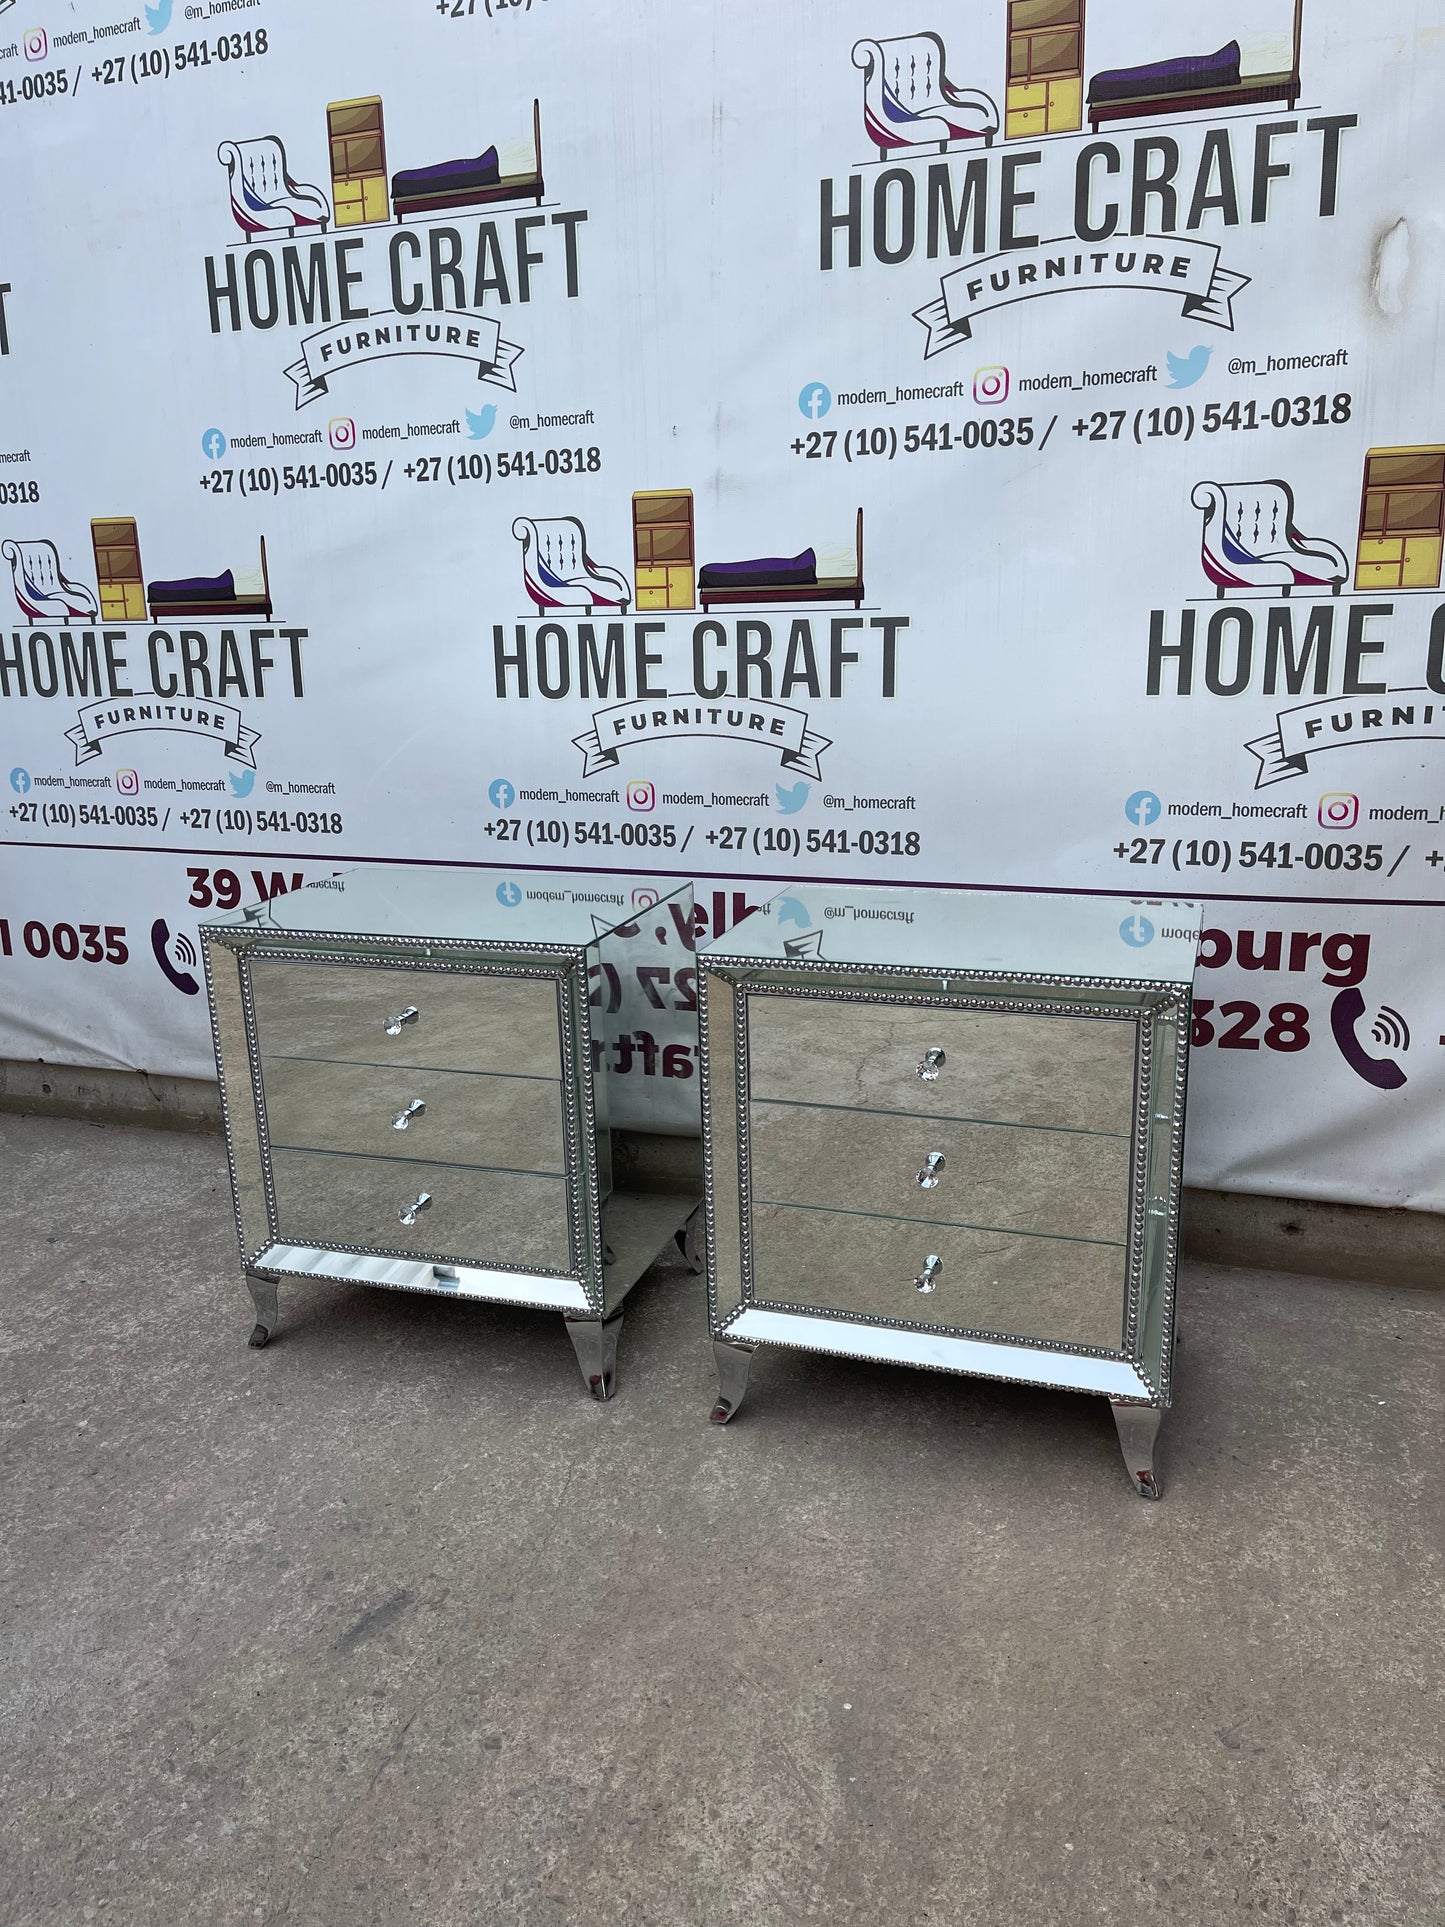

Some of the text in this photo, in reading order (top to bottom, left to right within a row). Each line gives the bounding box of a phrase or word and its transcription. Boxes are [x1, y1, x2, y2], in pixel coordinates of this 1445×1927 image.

[174, 28, 269, 70] 541-0318
[819, 113, 1358, 271] HOME CRAFT
[204, 210, 588, 334] HOME CRAFT
[966, 252, 1193, 301] FURNITURE
[320, 324, 481, 362] FURNITURE
[1227, 349, 1348, 376] @m_homecraft
[509, 410, 595, 430] @m_homecraft
[903, 417, 1033, 453] 541-0035
[1202, 392, 1352, 433] 541-0318
[283, 461, 377, 490] 541-0035
[497, 447, 601, 478] 541-0318
[0, 628, 308, 698] HOME CRAFT
[492, 616, 910, 699] HOME CRAFT
[1146, 603, 1394, 697] HOME
[94, 705, 225, 730] FURNITURE
[612, 707, 786, 736] FURNITURE
[1305, 705, 1445, 739] FURNI
[265, 781, 336, 795] @m_homecraft
[823, 794, 916, 811] @m_homecraft
[79, 804, 158, 827] 541-0035
[256, 810, 343, 835] 541-0318
[574, 821, 677, 848] 541-0035
[806, 828, 921, 857] 541-0318
[1238, 841, 1383, 872] 541-0035
[187, 867, 241, 910] 39
[23, 920, 129, 965] 0035
